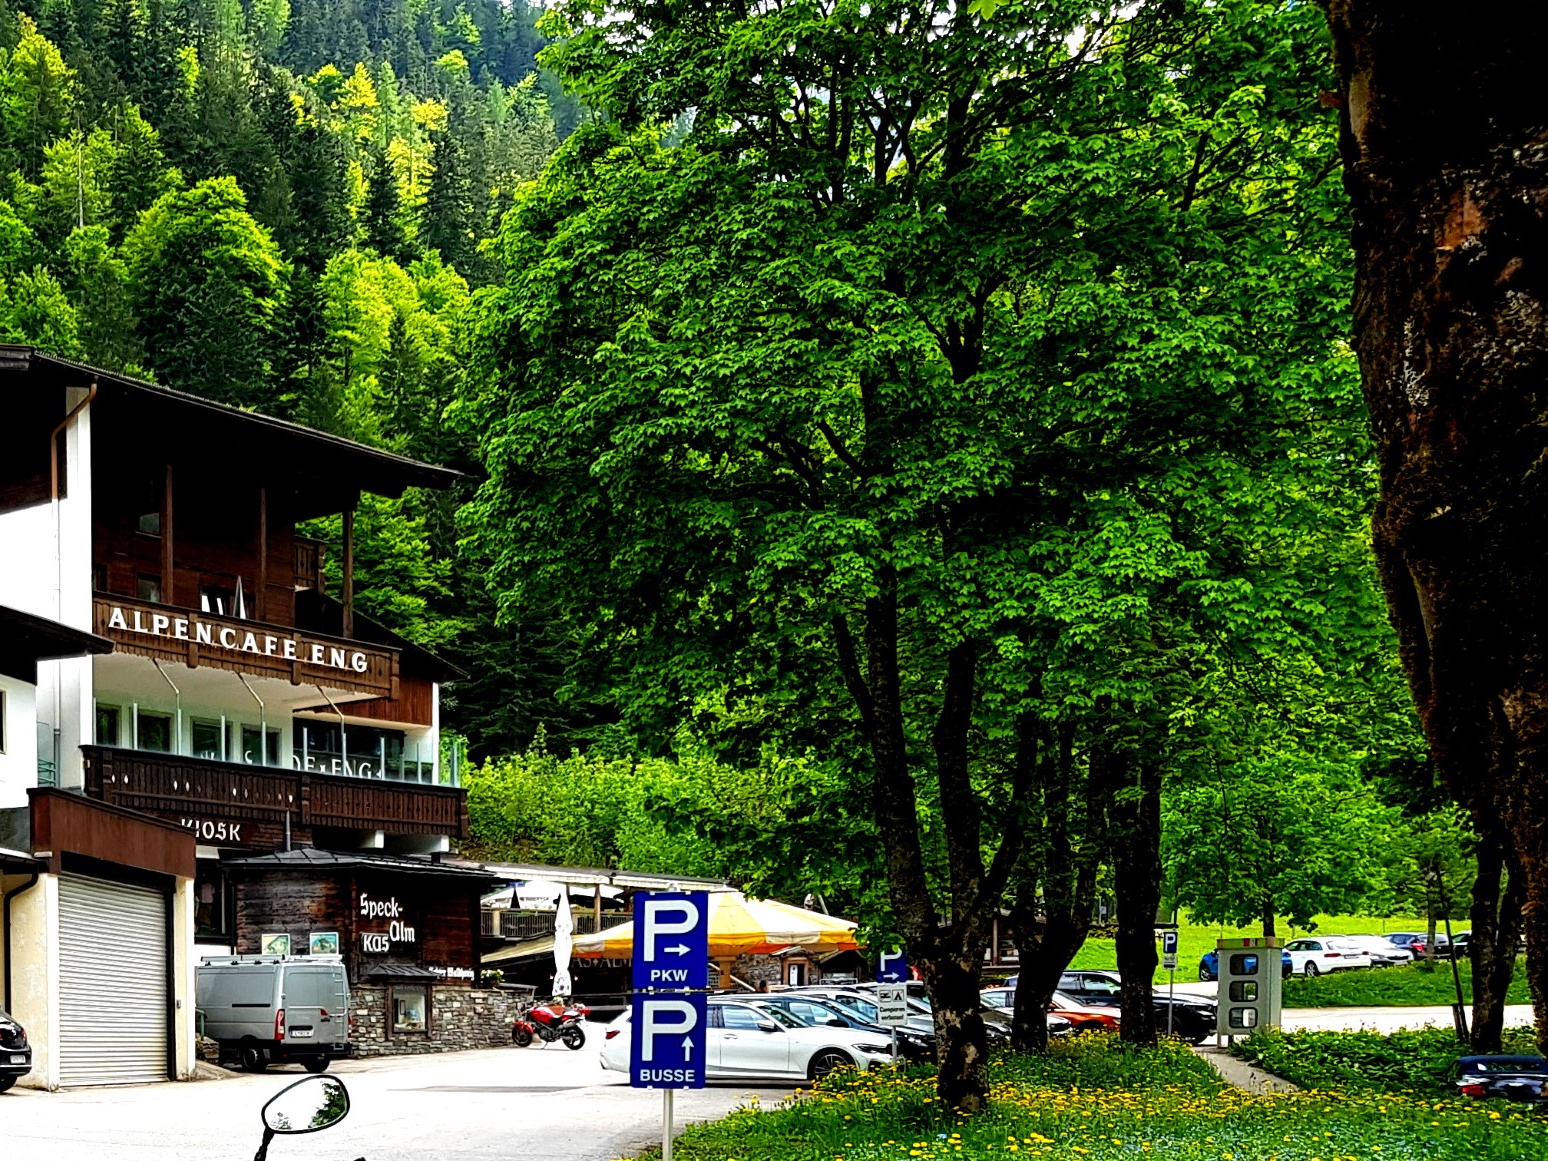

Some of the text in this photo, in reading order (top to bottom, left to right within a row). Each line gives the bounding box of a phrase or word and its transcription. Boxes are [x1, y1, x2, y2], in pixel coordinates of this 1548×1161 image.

[108, 607, 368, 673] ALPENCAFE ENG
[360, 893, 404, 920] Speck-
[643, 900, 700, 962] P
[1165, 933, 1177, 952] P
[650, 969, 688, 982] PKW
[641, 1000, 698, 1062] P
[639, 1069, 696, 1082] BUSSE
